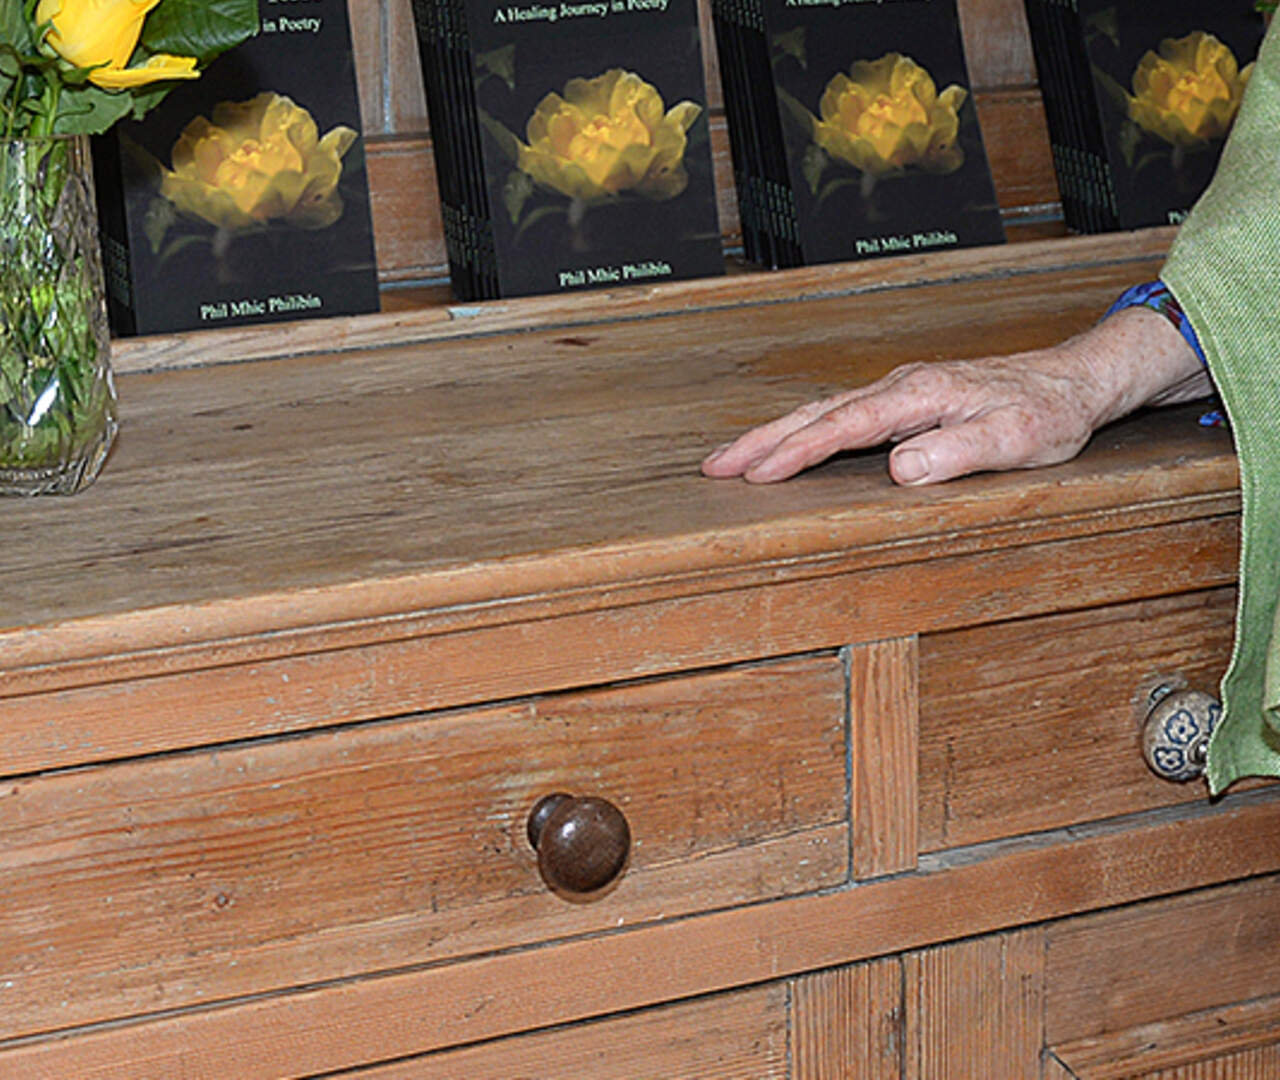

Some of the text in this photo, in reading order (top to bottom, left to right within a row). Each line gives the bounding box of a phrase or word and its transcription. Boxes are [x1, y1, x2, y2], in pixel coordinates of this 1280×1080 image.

[494, 9, 507, 23] A
[507, 5, 557, 22] Healing
[559, 3, 609, 17] Journey
[263, 16, 322, 32] in Poetry
[855, 239, 880, 254] Phil
[881, 236, 911, 250] Mhic
[559, 270, 586, 287] Phil
[586, 266, 620, 283] Mhic
[200, 303, 228, 320] Phil
[230, 299, 266, 317] Mhic
